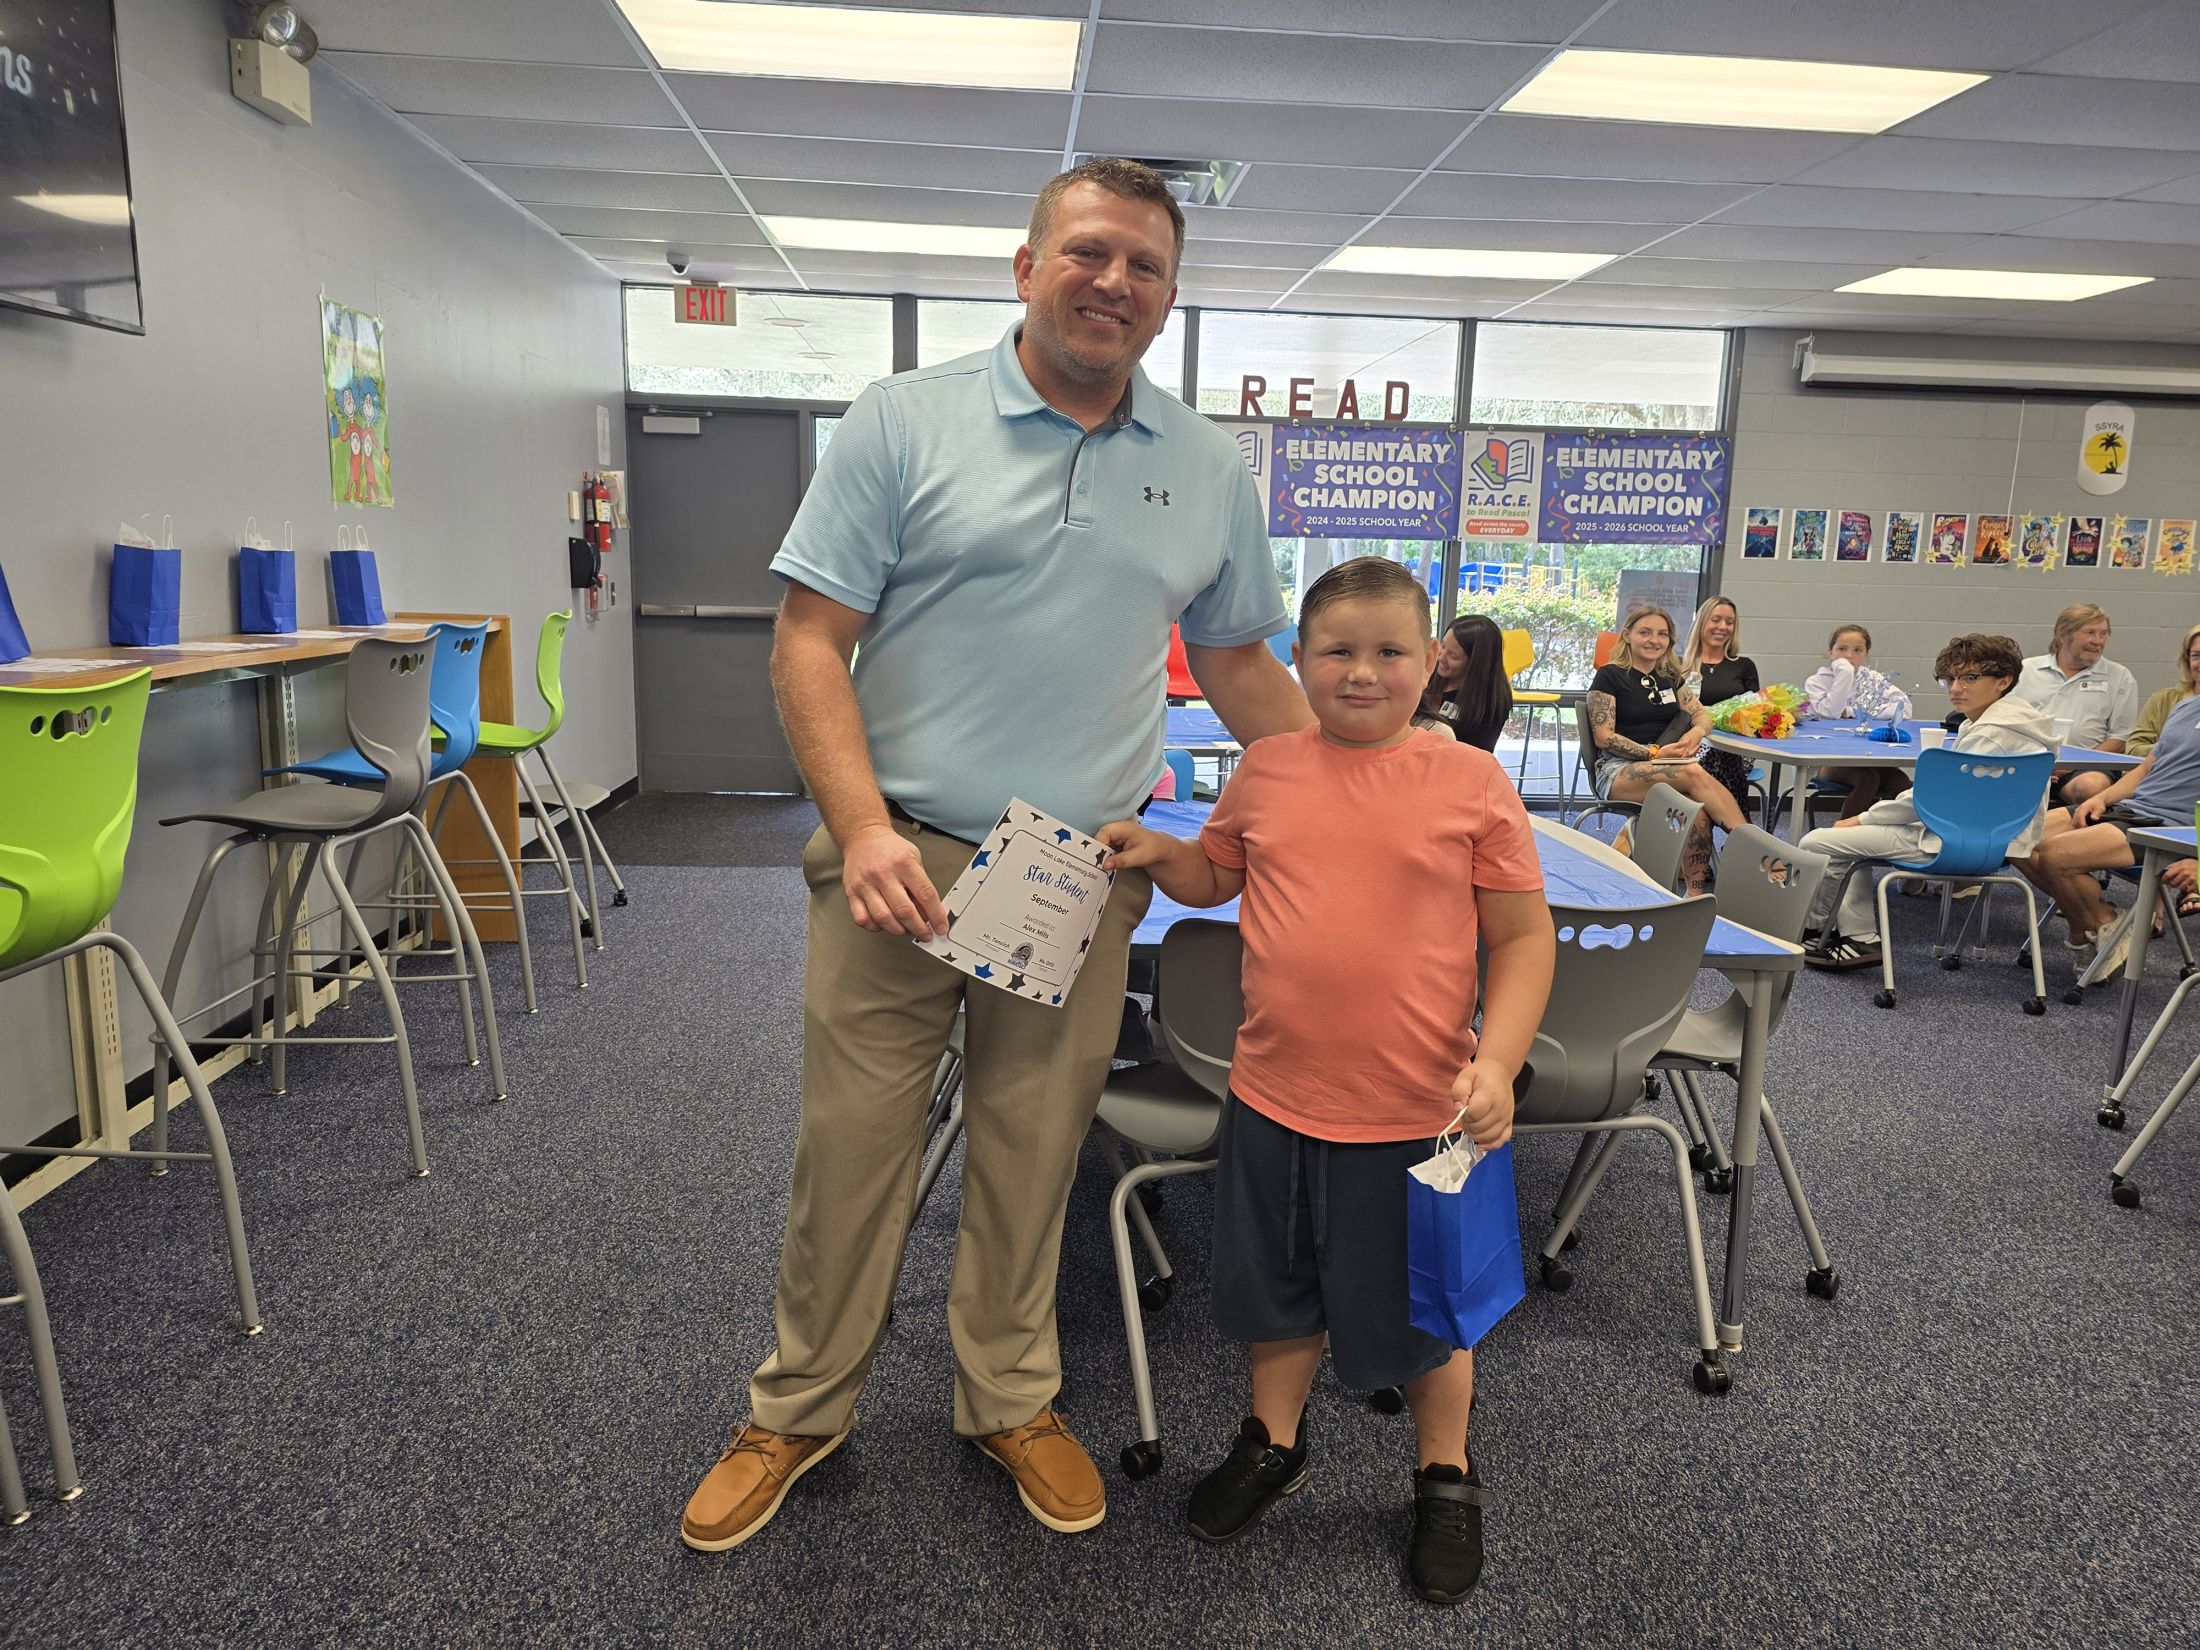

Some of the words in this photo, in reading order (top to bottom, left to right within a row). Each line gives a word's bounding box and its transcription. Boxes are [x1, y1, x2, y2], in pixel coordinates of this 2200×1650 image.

[685, 287, 727, 322] EXIT
[1240, 374, 1410, 422] READ
[2095, 422, 2124, 432] SSYRA
[1286, 439, 1451, 464] ELEMENTARY
[1556, 447, 1720, 470] ELEMENTARY
[1314, 464, 1419, 486] SCHOOL
[1584, 471, 1687, 493] SCHOOL
[1293, 487, 1435, 510] CHAMPION
[1467, 493, 1531, 507] R.A.C.E.
[1564, 494, 1703, 516] CHAMPION
[1306, 516, 1328, 525] 2024
[1335, 517, 1357, 526] 2025
[1359, 517, 1397, 527] SCHOOL
[1398, 518, 1421, 527] YEAR
[1467, 508, 1476, 516] to
[1478, 508, 1500, 517] Read
[1502, 509, 1531, 517] Pasco!
[1576, 522, 1597, 531] 2025
[1604, 522, 1626, 531] 2026
[1628, 523, 1665, 533] SCHOOL
[1666, 524, 1689, 533] YEAR
[1040, 848, 1054, 859] Moon
[1053, 855, 1066, 866] Lake
[1023, 864, 1054, 886] Star
[1054, 872, 1090, 905] Student
[1030, 893, 1069, 916] September
[1022, 923, 1037, 934] Alex
